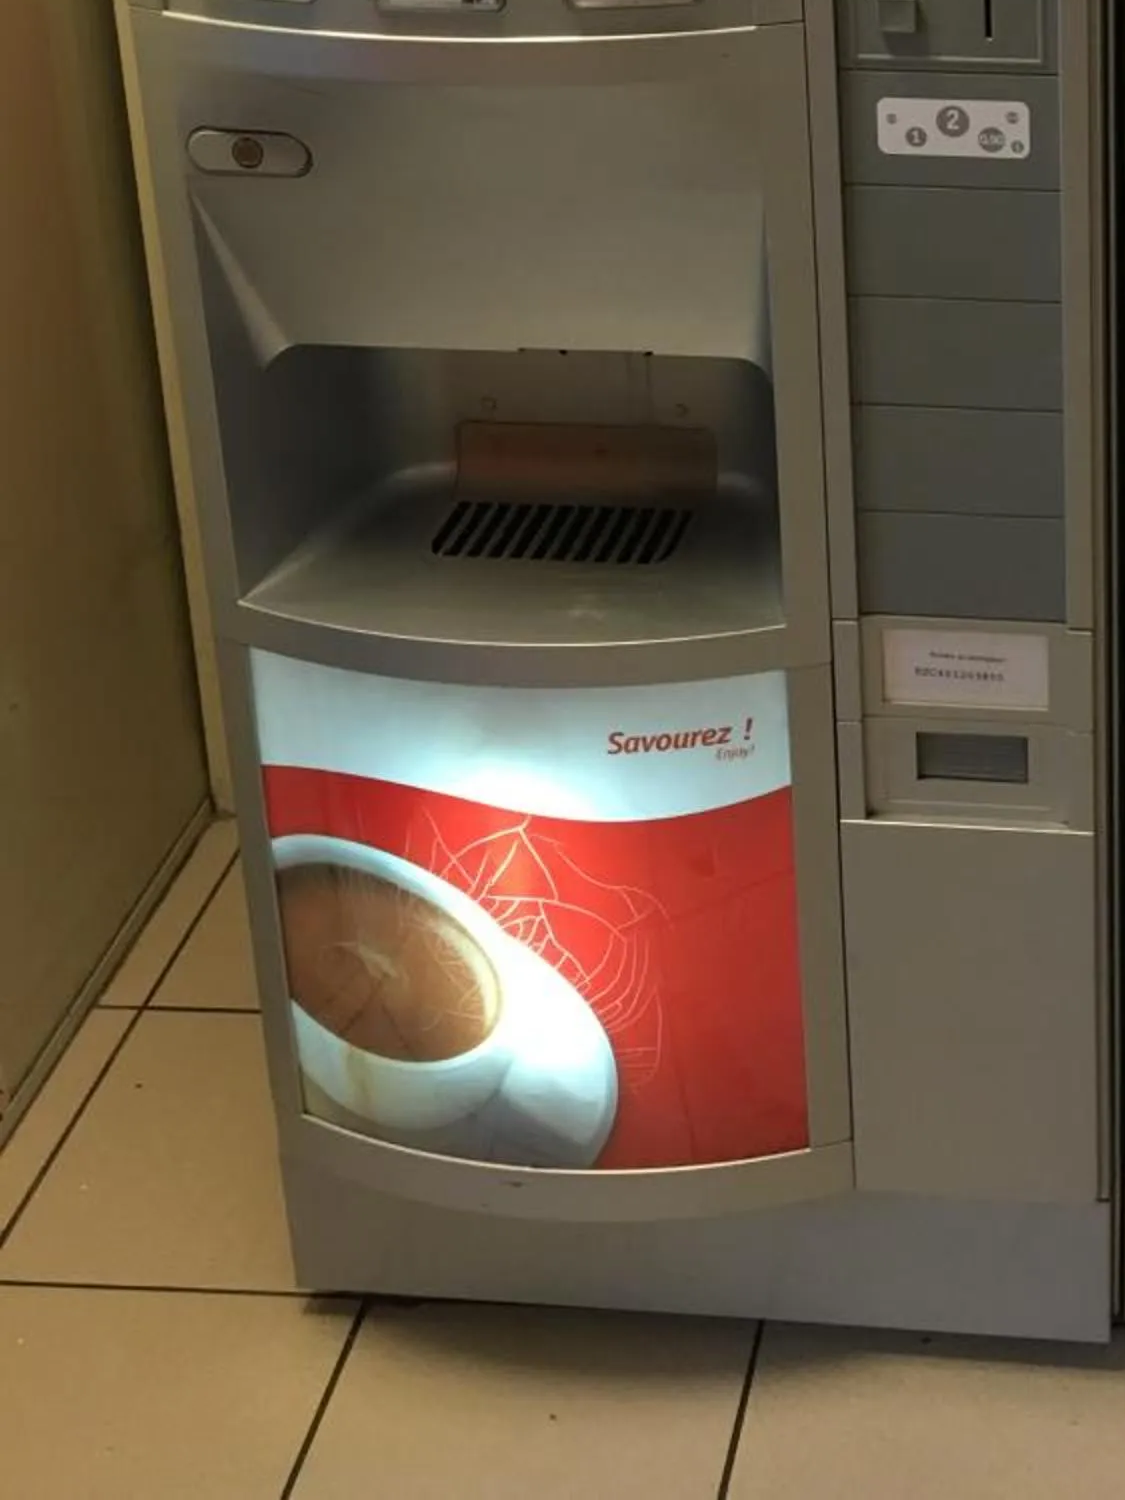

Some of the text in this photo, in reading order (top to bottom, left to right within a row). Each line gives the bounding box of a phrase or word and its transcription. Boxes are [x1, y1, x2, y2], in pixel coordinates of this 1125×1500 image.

[946, 110, 959, 130] 2
[912, 130, 920, 143] 1
[608, 726, 732, 755] Savourez
